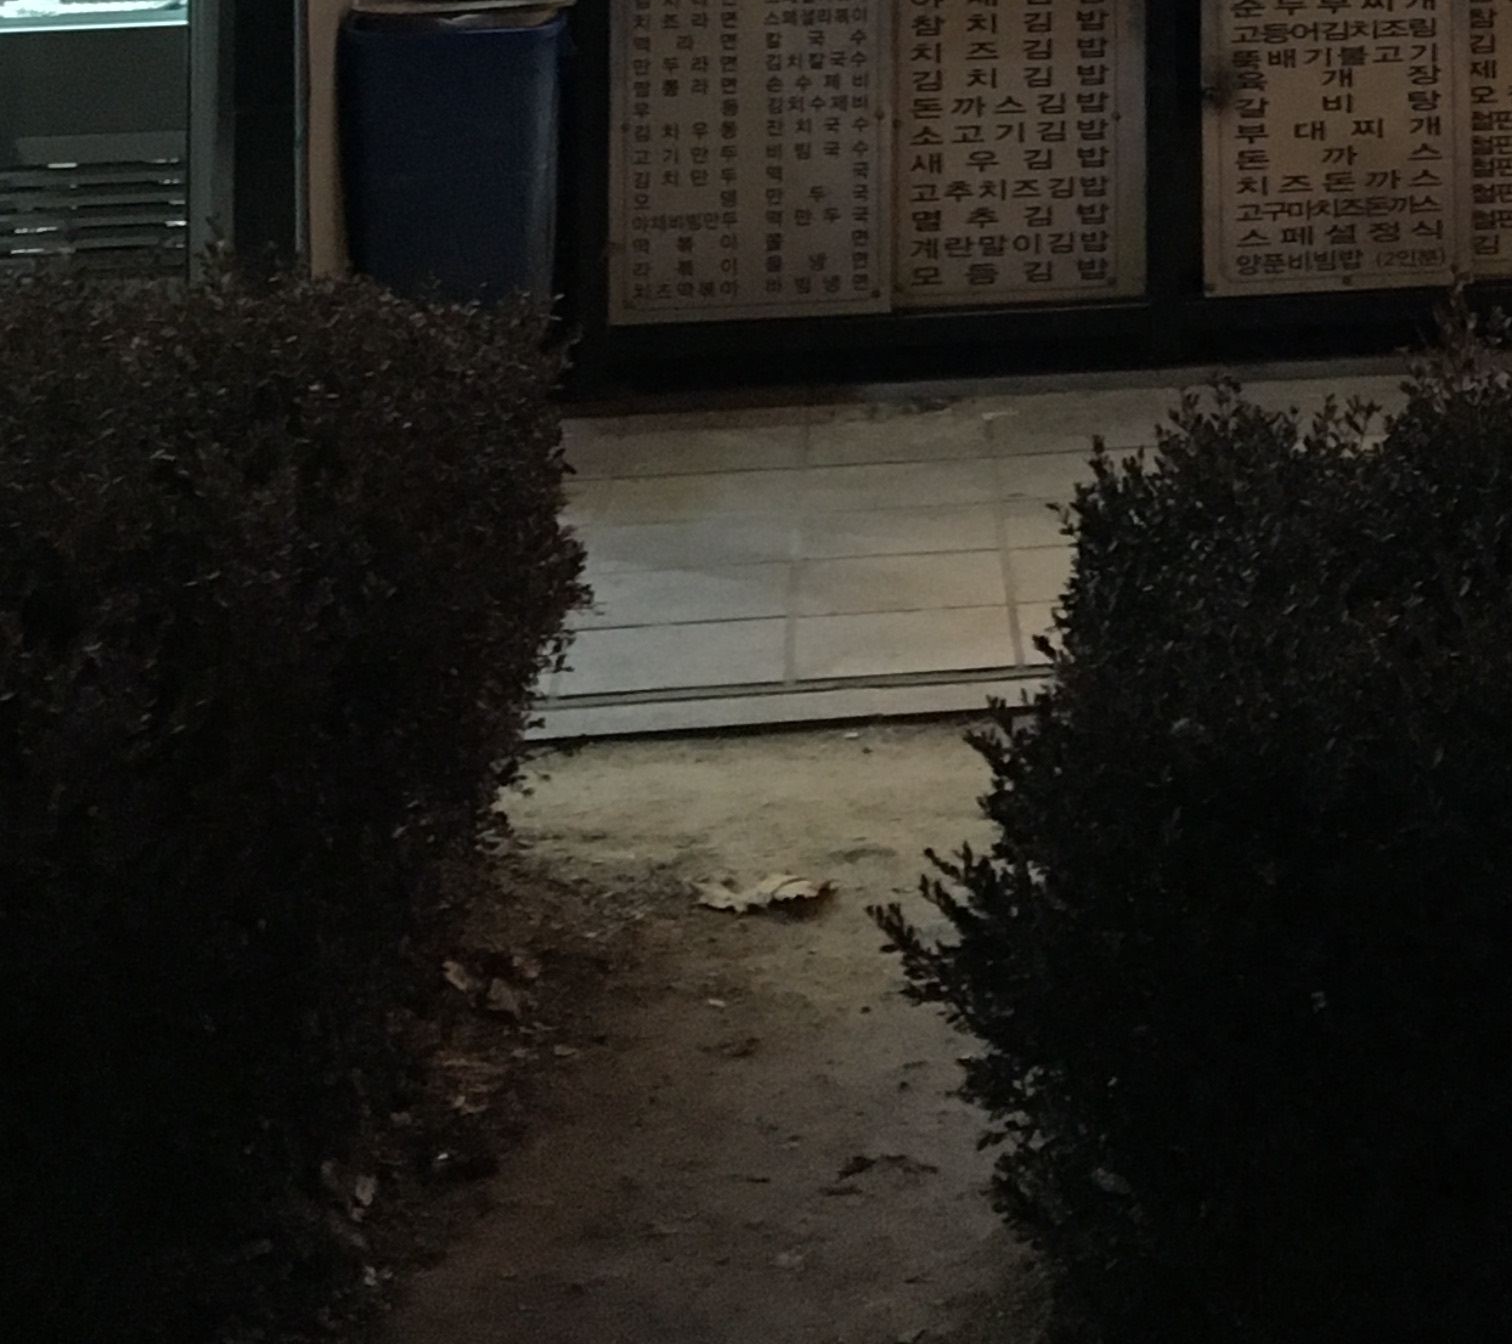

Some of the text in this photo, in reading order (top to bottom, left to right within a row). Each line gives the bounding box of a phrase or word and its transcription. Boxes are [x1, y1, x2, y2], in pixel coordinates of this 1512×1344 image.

[911, 10, 1110, 37] 참치김밥
[1231, 17, 1438, 44] 고등어김치조림
[911, 37, 1109, 63] 치즈김밥
[912, 64, 1109, 92] 김치김밥
[1237, 64, 1440, 91] 육개장
[912, 92, 1109, 119] 돈까스김밥
[1236, 90, 1441, 119] 갈비탕
[910, 118, 1109, 146] 소고기김밥
[1235, 116, 1442, 144] 부대찌개
[633, 145, 738, 165] 고기만두
[911, 146, 1109, 174] 새우김밥
[1236, 143, 1443, 171] 돈까스
[633, 167, 737, 190] 김치만두
[911, 175, 1109, 203] 고추치즈김밥
[1236, 169, 1443, 196] 치즈돈까스
[1236, 195, 1443, 222] 고구마치즈돈까스
[911, 230, 1109, 260] 계란말이김밥
